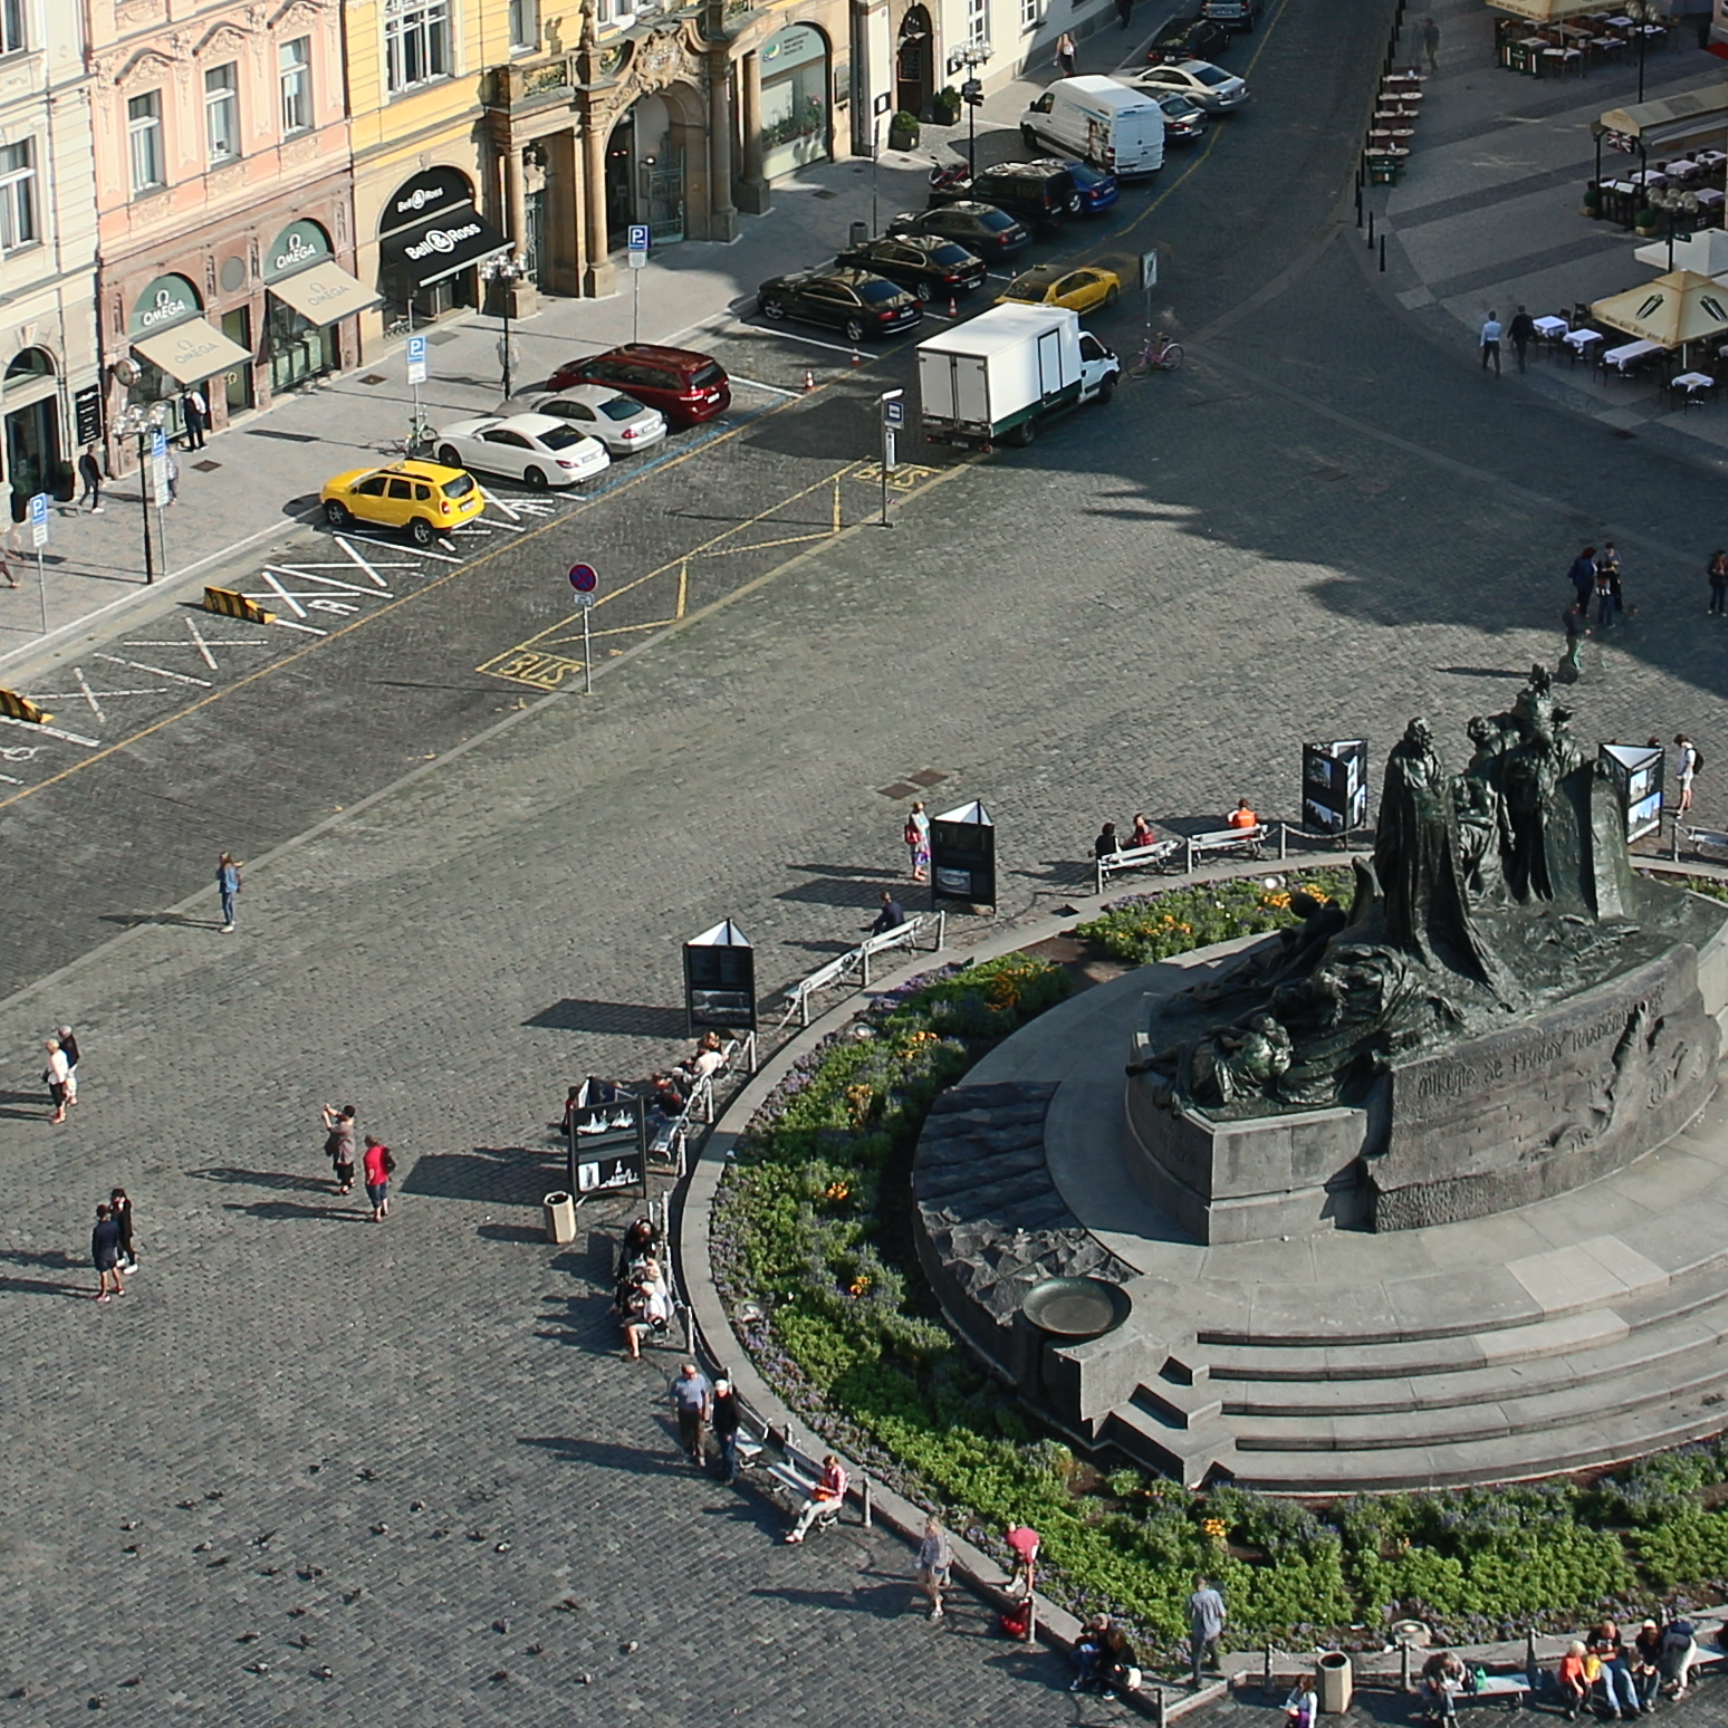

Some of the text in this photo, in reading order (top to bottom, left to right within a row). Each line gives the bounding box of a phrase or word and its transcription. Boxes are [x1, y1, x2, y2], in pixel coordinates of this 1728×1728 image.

[397, 198, 414, 213] Bell
[424, 186, 444, 201] Ross
[404, 240, 434, 261] Bell
[447, 222, 482, 243] Ross
[275, 243, 317, 270] OMEGA
[307, 285, 351, 307] OMEGA
[142, 298, 186, 327] OMEGA
[174, 341, 220, 365] OMEGA
[498, 652, 583, 685] BUS
